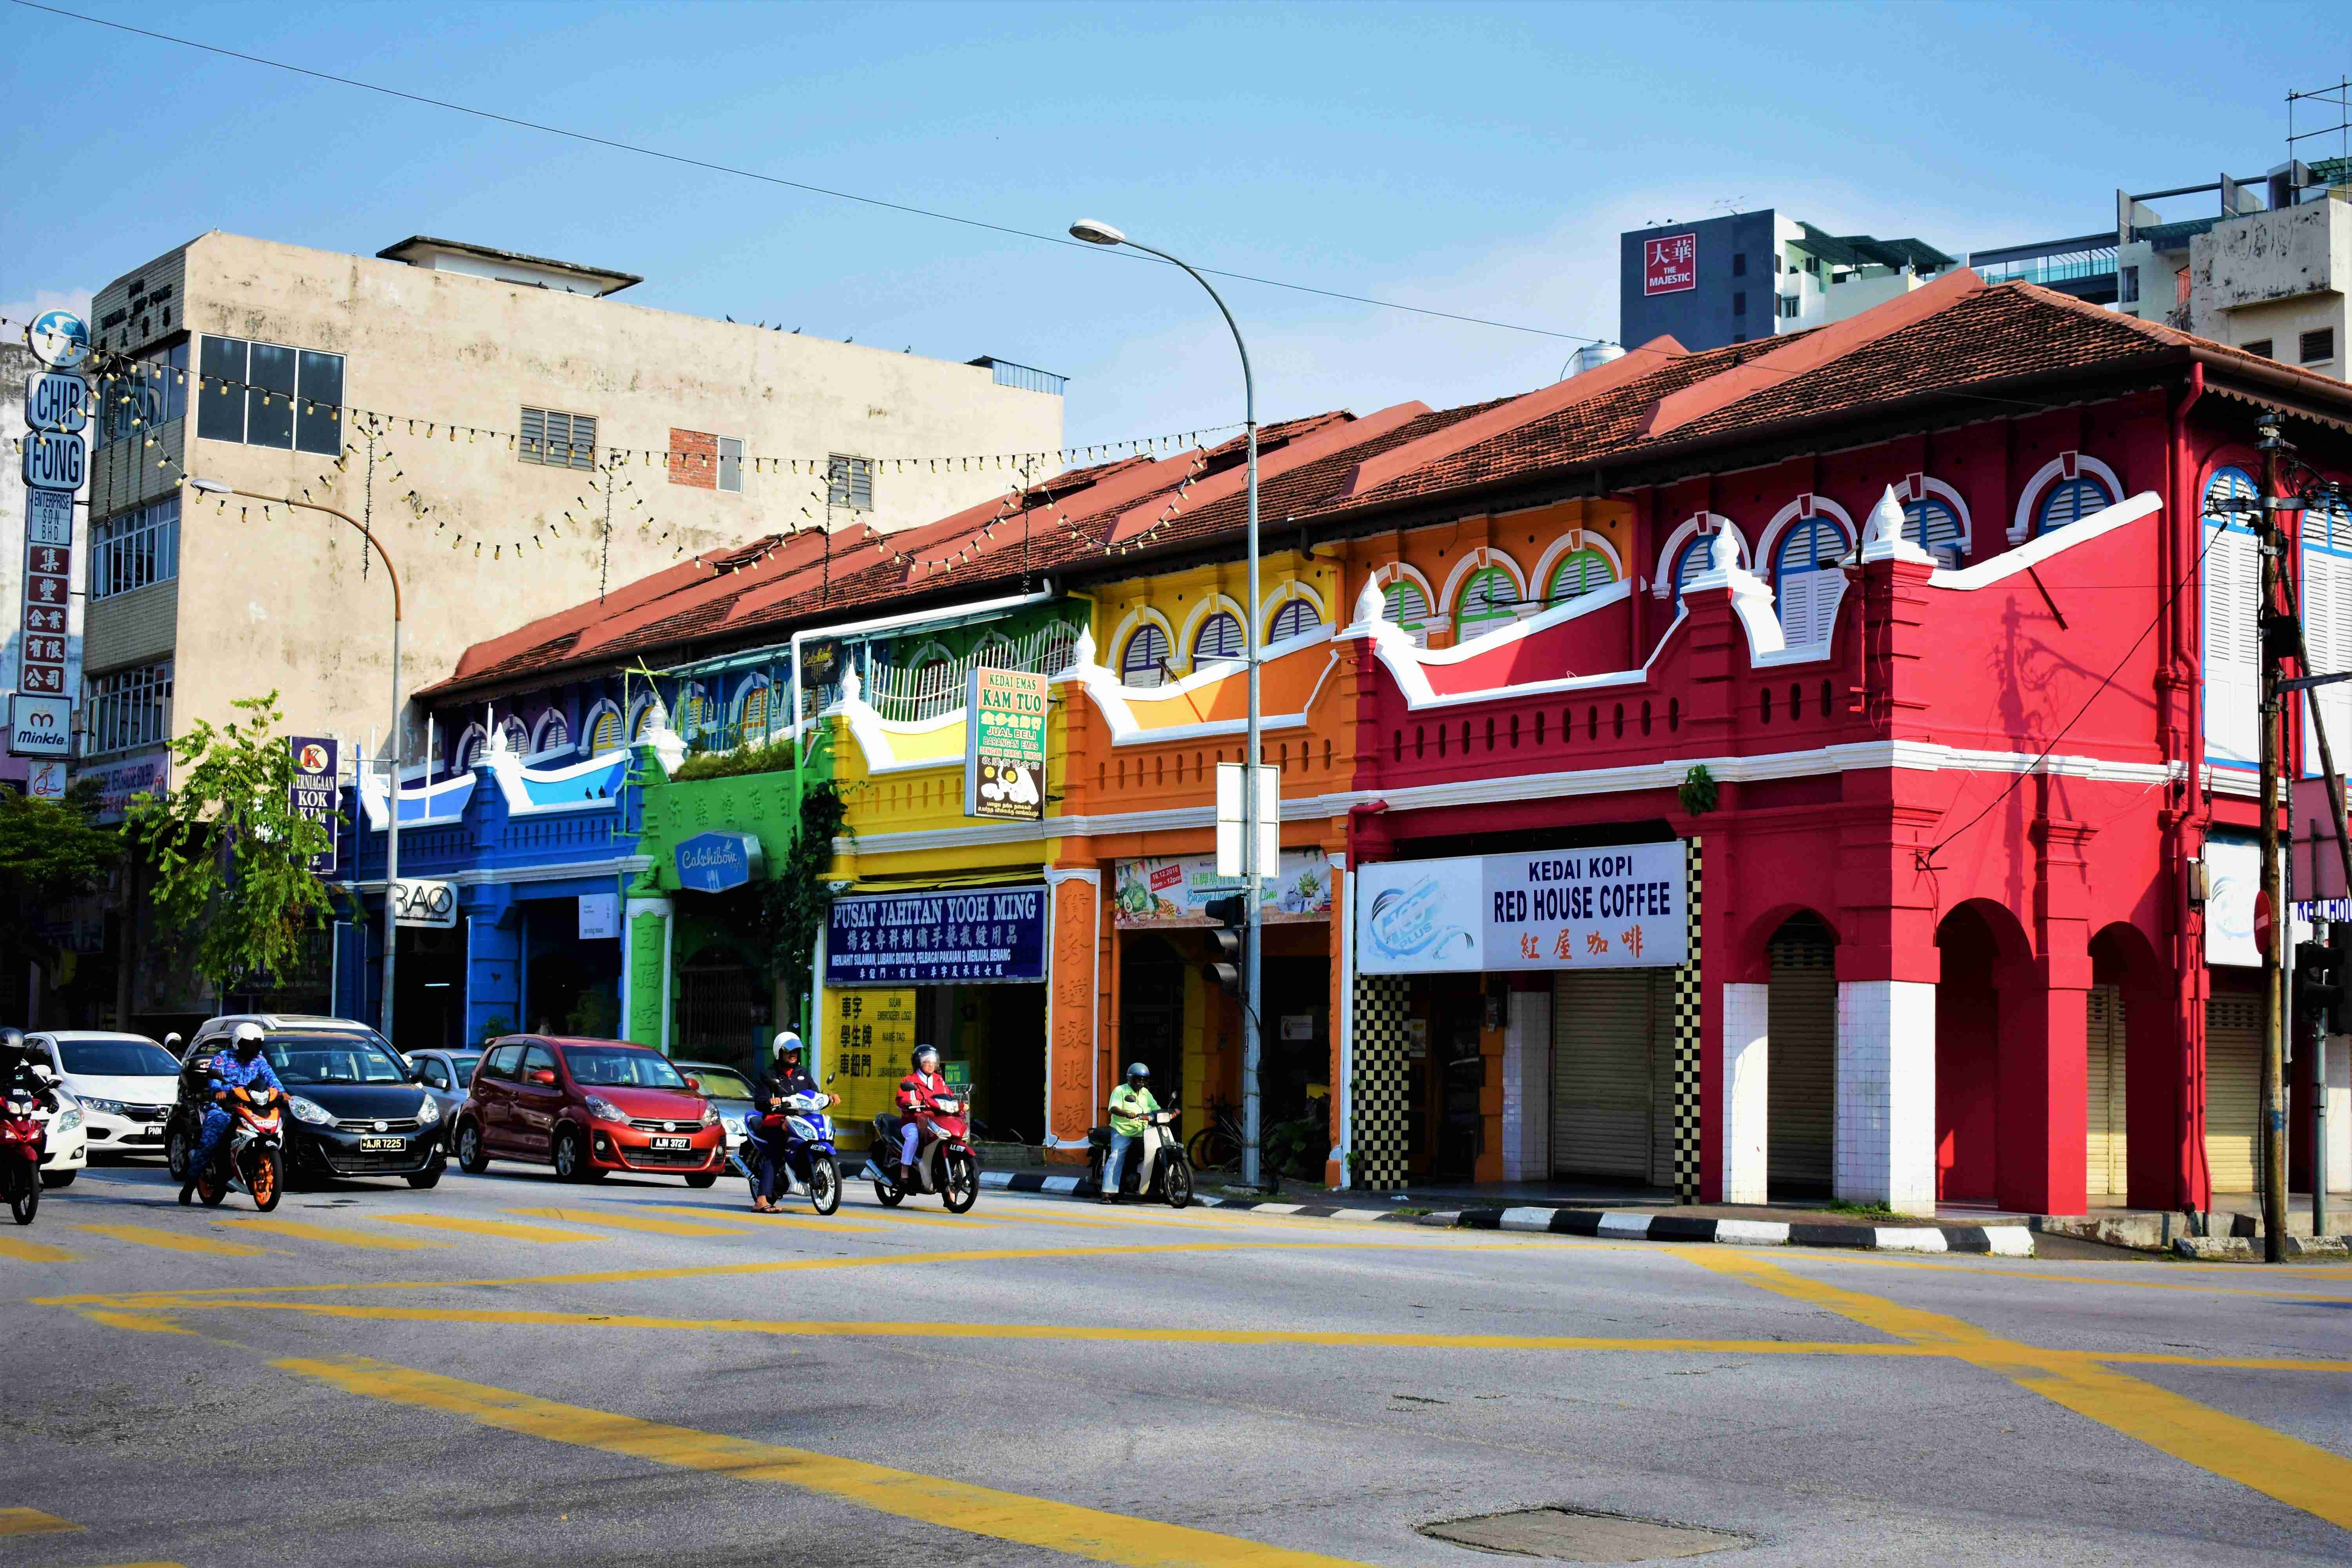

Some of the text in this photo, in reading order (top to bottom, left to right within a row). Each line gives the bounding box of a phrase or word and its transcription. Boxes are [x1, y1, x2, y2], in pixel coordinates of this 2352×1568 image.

[1650, 240, 1692, 268] 大華
[1649, 272, 1690, 287] MAJESTIC
[38, 379, 79, 424] CHIP
[33, 437, 79, 483] FONG
[34, 491, 70, 510] ENTERPRISE
[989, 674, 1036, 690] KEDAI EMAS
[983, 689, 1042, 712] KAM TUO
[987, 726, 1036, 740] JUAL BELI
[980, 746, 1042, 760] DENGAN HARGA TINGGI
[983, 737, 1038, 750] BARANGAN EMAS
[301, 747, 323, 769] K
[298, 791, 328, 807] KOK
[299, 808, 327, 824] KIM
[1152, 866, 1178, 880] 16.12.2018
[1529, 855, 1632, 882] KEDAI KOPI
[1167, 875, 1181, 884] 12pm
[833, 893, 1036, 929] PUSAT JAHITAN YOOH MING
[1494, 881, 1671, 923] RED HOUSE COFFEE
[1398, 922, 1432, 949] PLUS
[1521, 924, 1643, 960] 紅屋咖啡
[832, 948, 1011, 967] MENJAHIT SULAMAN, LUBANG BUTANG, PELBAGAI PAKAIAN & MENJUAL BENANG
[842, 996, 862, 1019] 車字
[901, 1011, 912, 1020] LOGO
[840, 1024, 872, 1048] 學生牌
[882, 1032, 905, 1042] NAME TAG
[367, 1139, 401, 1148] AJR 7225
[670, 1139, 687, 1148] 3727
